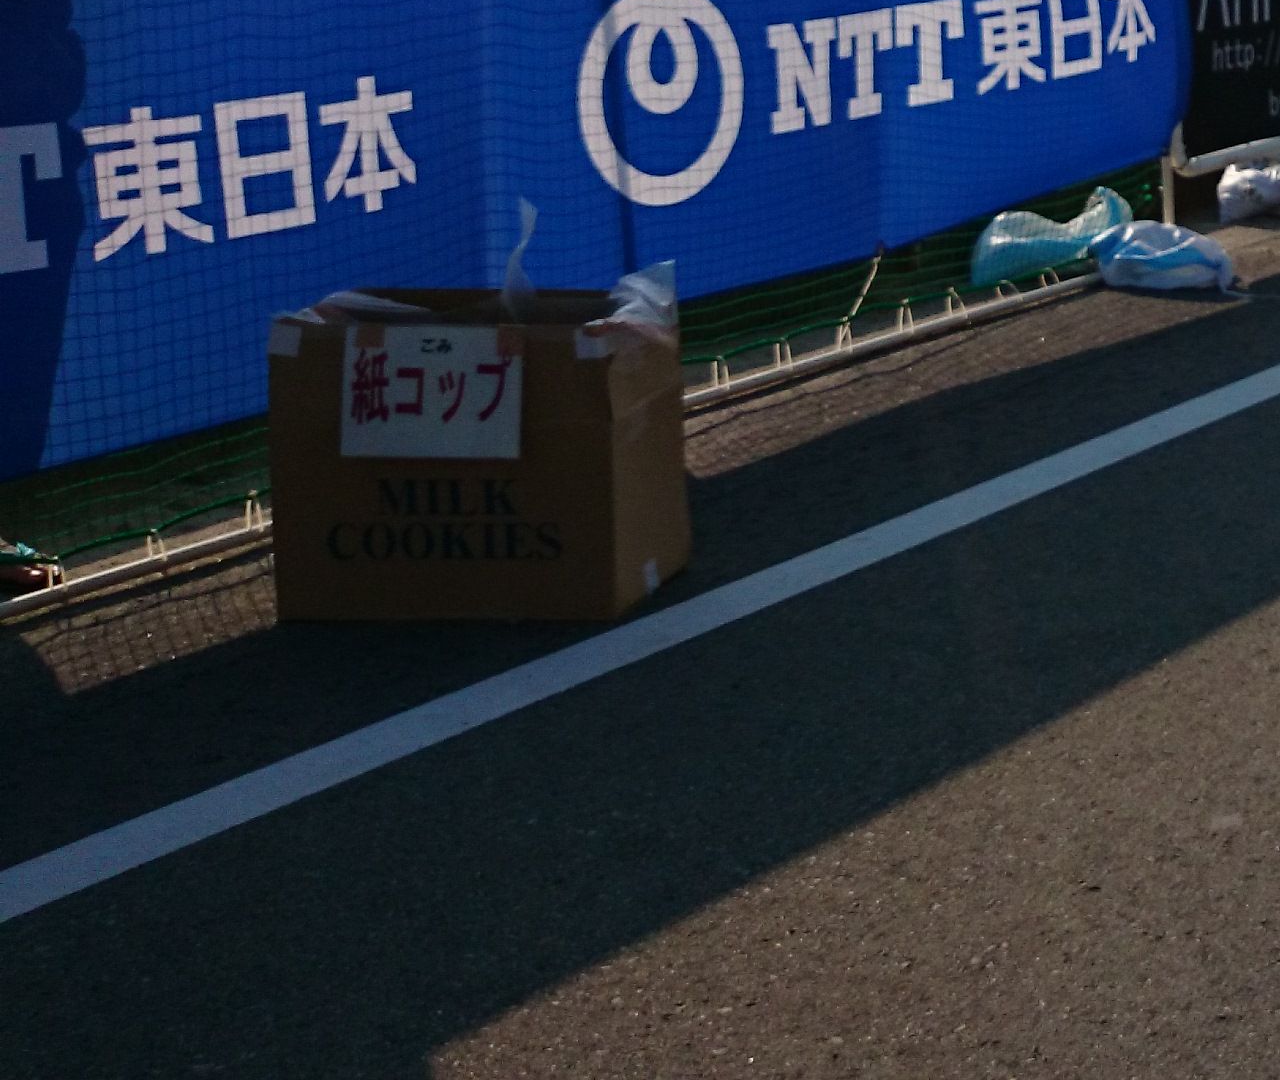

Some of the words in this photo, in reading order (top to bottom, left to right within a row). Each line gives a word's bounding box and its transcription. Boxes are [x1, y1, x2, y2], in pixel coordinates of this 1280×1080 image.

[420, 338, 452, 353] ごみ
[351, 348, 514, 425] 紙コップ
[378, 478, 519, 516] MILK
[326, 521, 562, 561] COOKIES
